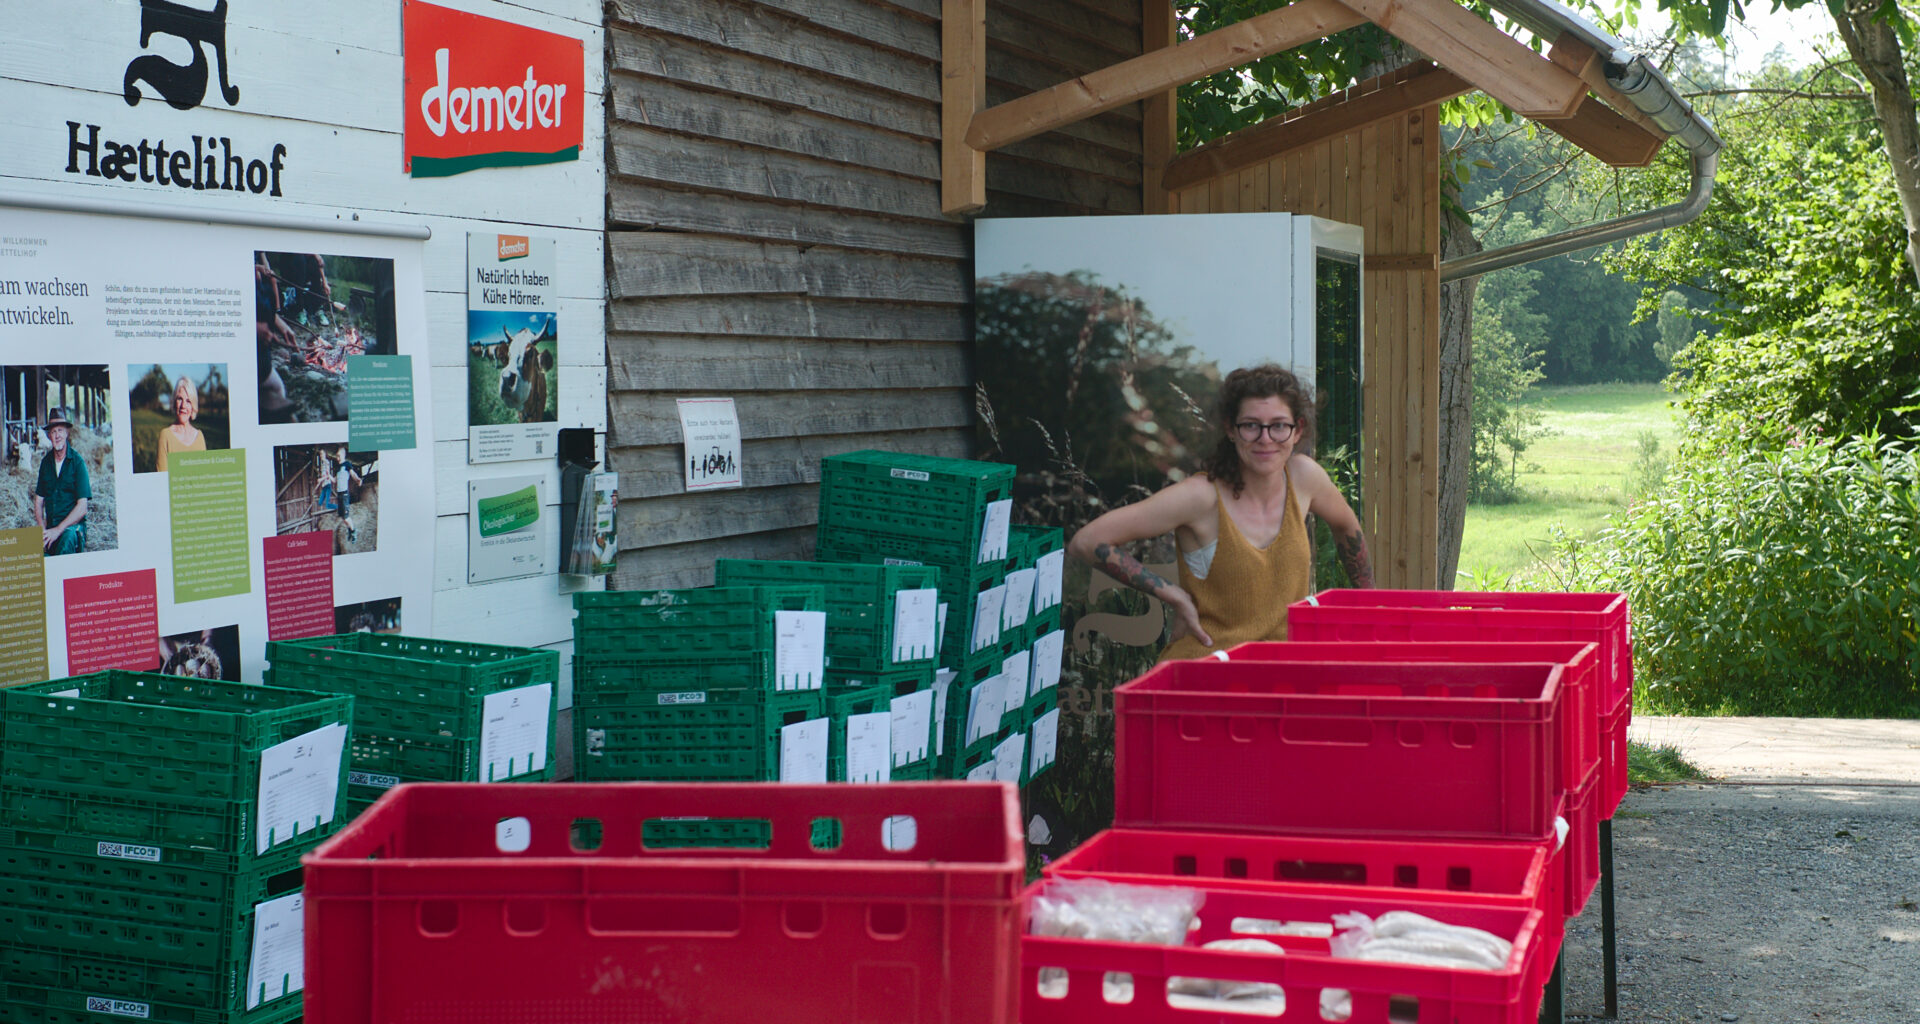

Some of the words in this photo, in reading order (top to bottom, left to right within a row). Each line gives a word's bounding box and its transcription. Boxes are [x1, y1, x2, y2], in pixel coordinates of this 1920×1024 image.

[421, 48, 567, 137] demeter
[66, 121, 287, 197] Hættelihof
[2, 237, 48, 246] WILLKOMMEN
[500, 240, 526, 256] demeter
[477, 267, 520, 285] Natürlich
[522, 269, 549, 286] haben
[24, 277, 89, 297] wachsen
[482, 288, 508, 304] Kühe
[510, 289, 544, 305] Hörner.
[483, 514, 516, 530] Ökologischer
[98, 581, 124, 590] Produkte
[125, 846, 146, 855] IFCO
[114, 1001, 136, 1012] IFCO
